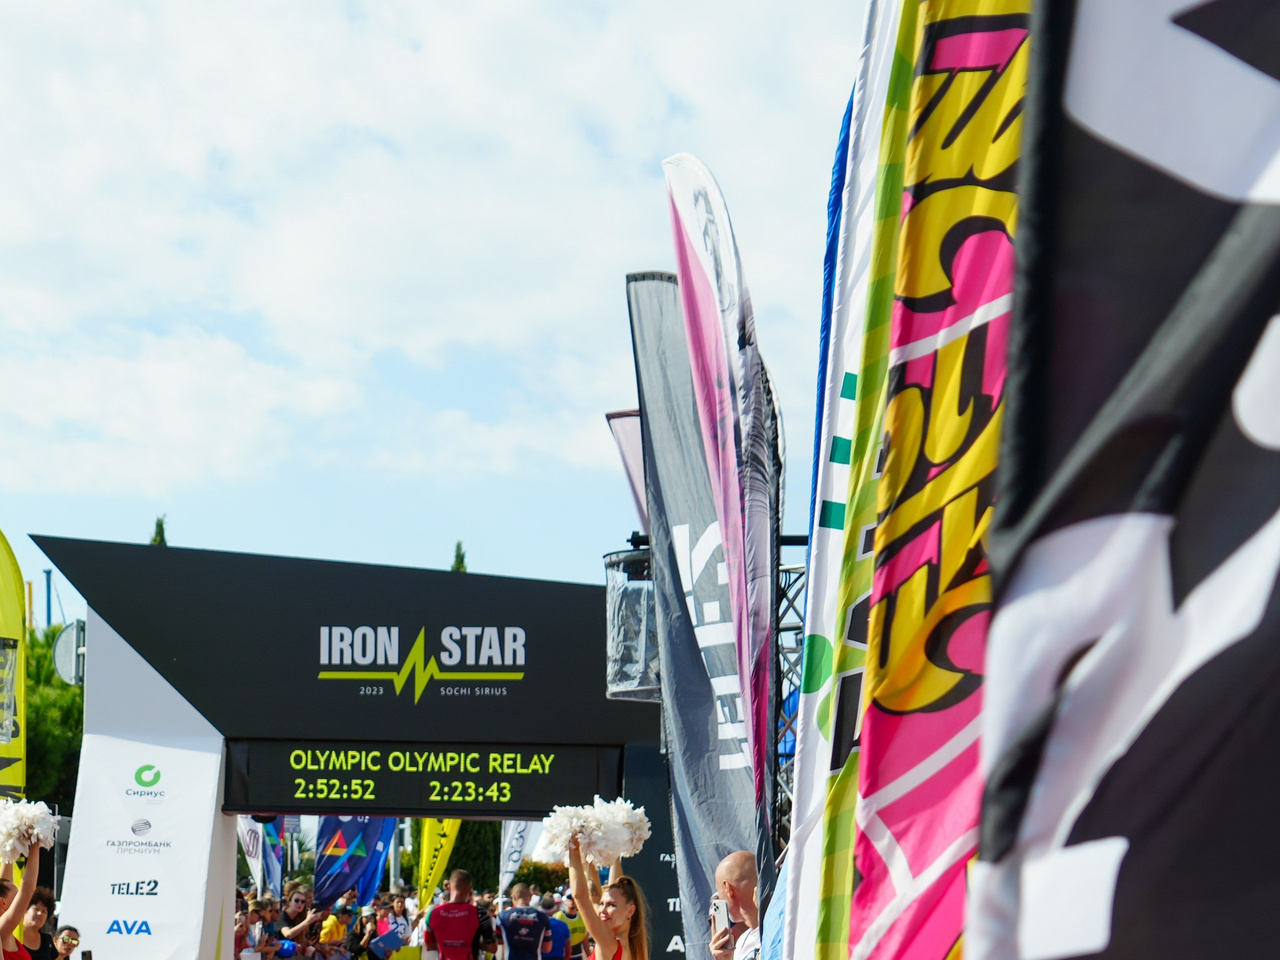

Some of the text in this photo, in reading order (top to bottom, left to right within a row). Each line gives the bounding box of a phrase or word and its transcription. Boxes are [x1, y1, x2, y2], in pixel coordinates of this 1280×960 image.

[319, 626, 526, 666] IRON STAR
[359, 686, 507, 696] 2023 SOCHI SIRIUS
[289, 750, 555, 774] OLYMPIC OLYMPIC RELAY
[125, 788, 165, 798] Сириус
[294, 778, 512, 802] 2:52:52 2:23:43
[106, 840, 172, 848] ГАЗПРОМБАНК
[110, 879, 159, 896] TELE2
[106, 919, 153, 935] AVA
